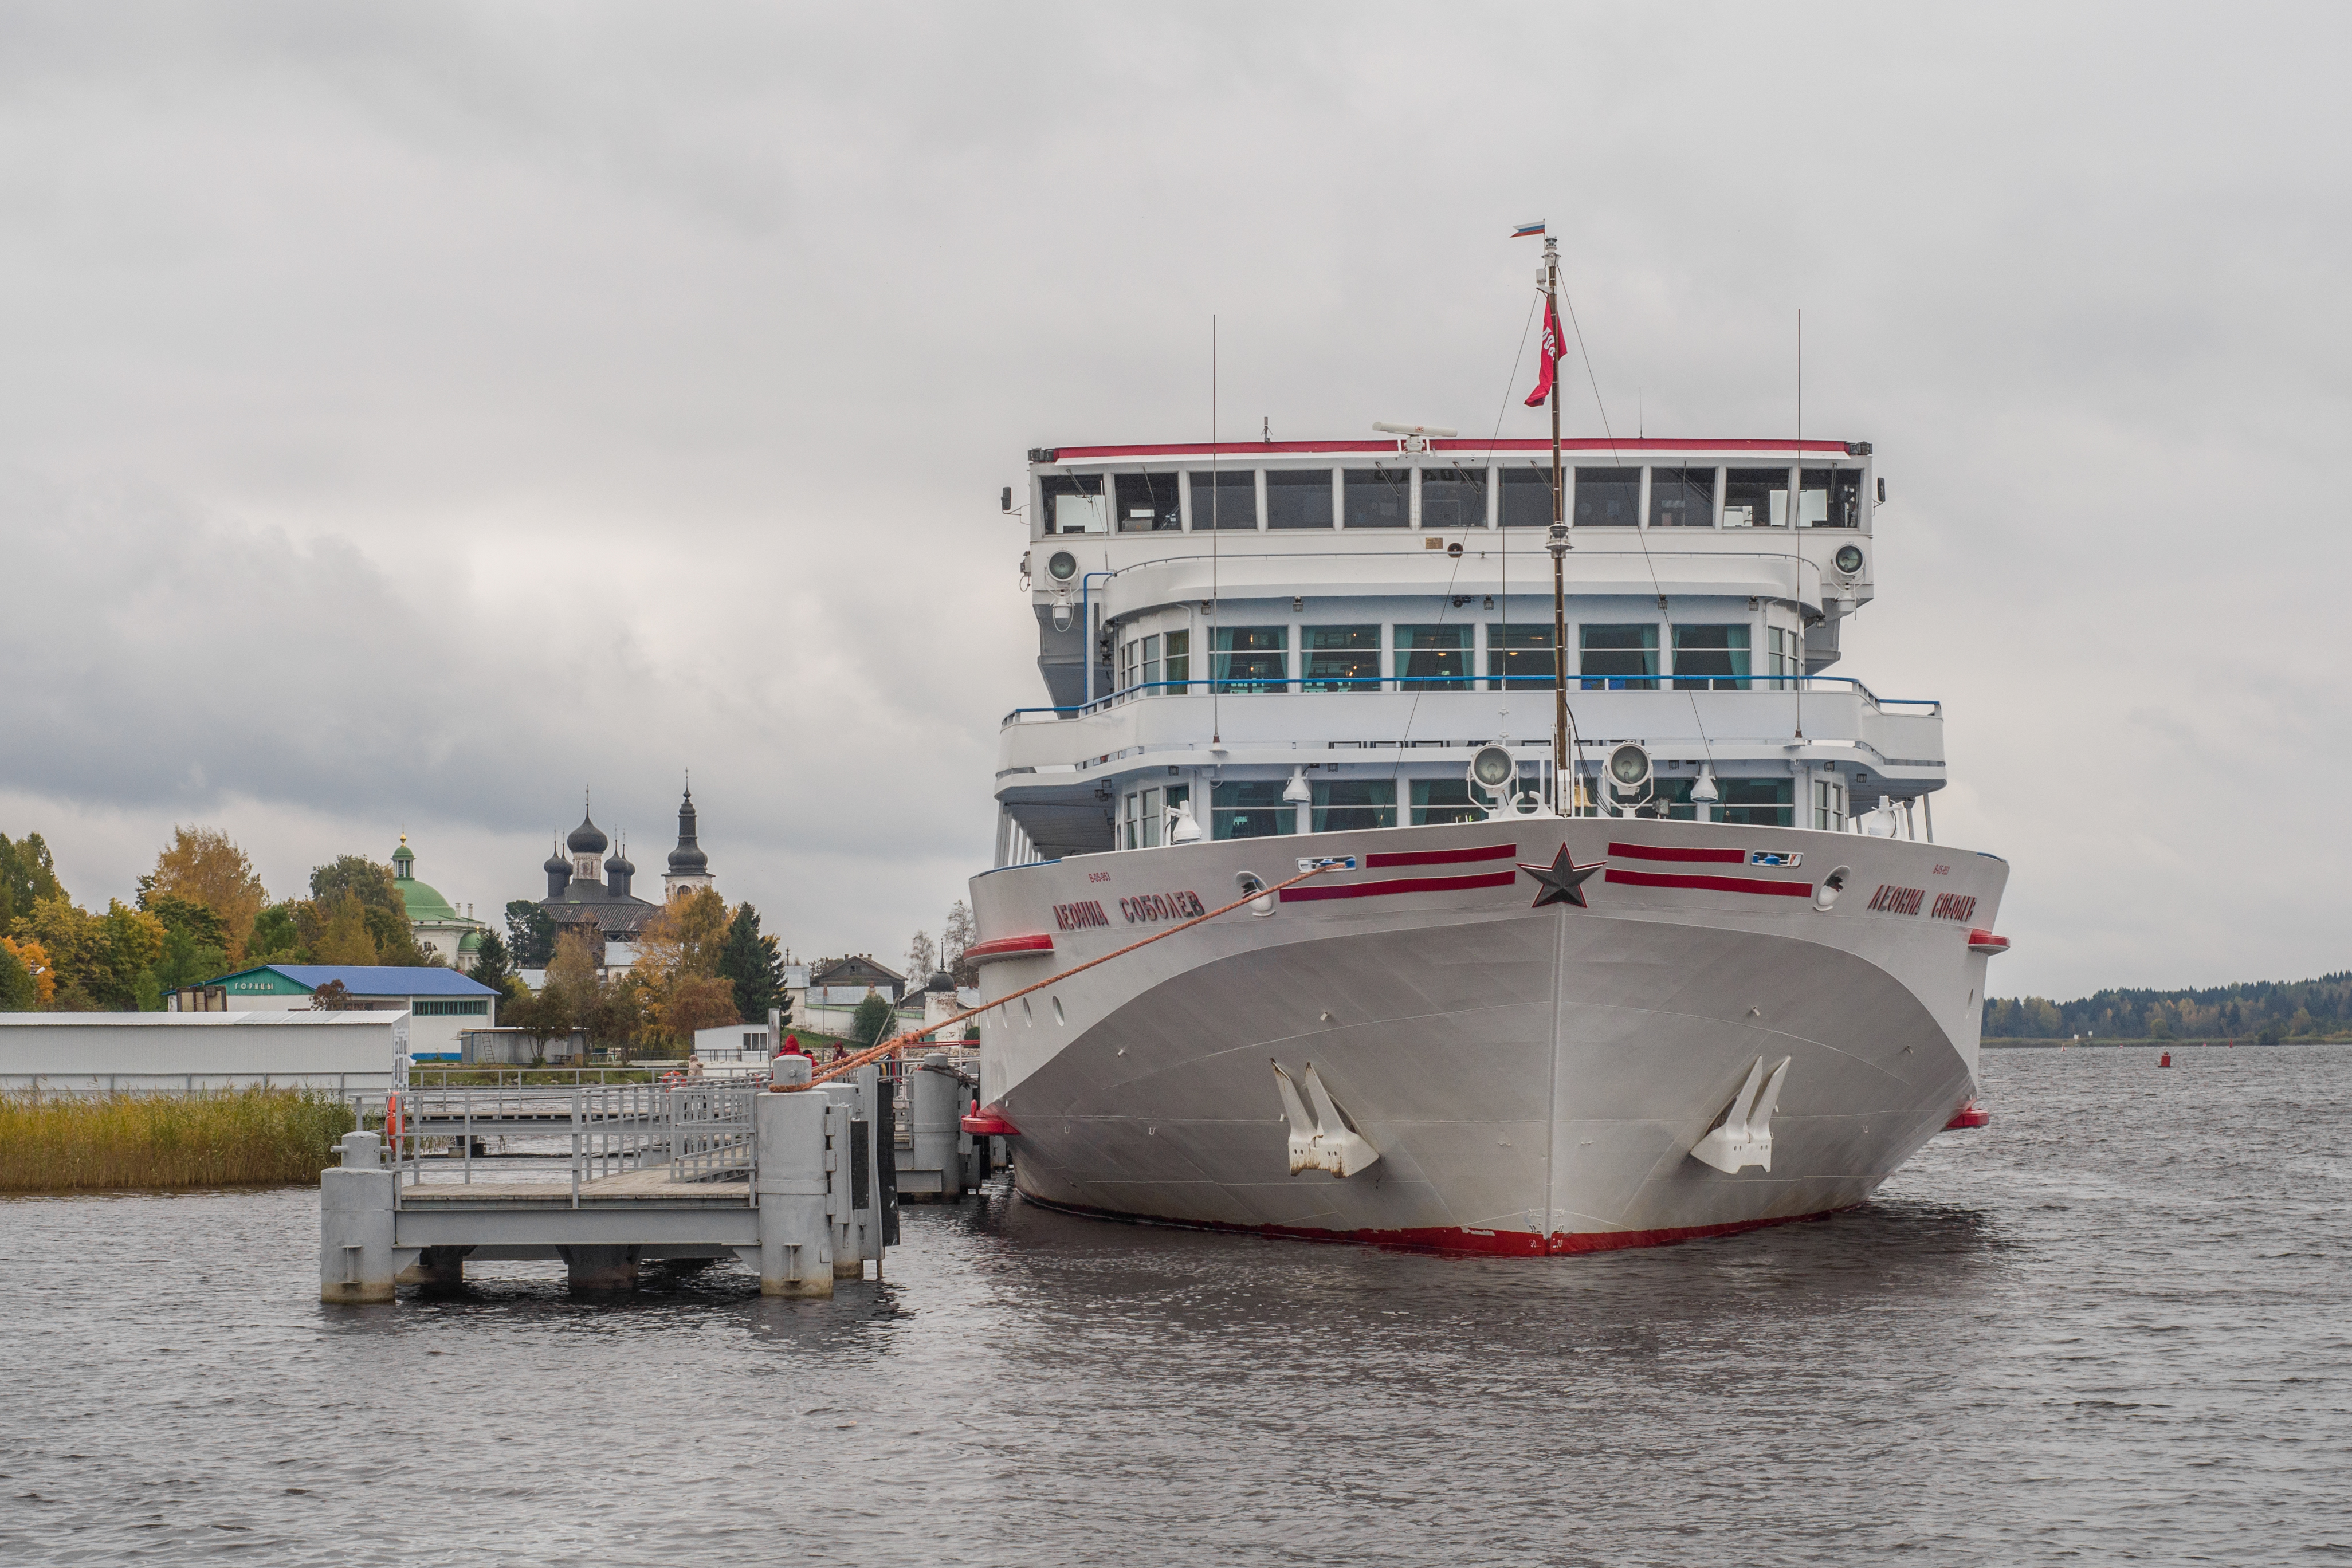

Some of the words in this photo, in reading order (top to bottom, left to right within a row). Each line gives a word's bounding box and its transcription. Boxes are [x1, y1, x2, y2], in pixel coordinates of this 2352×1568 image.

[1052, 900, 1109, 930] ЛЕОНИД
[1118, 890, 1205, 923] СОБОЛЕВ
[1529, 1239, 1537, 1248] 30
